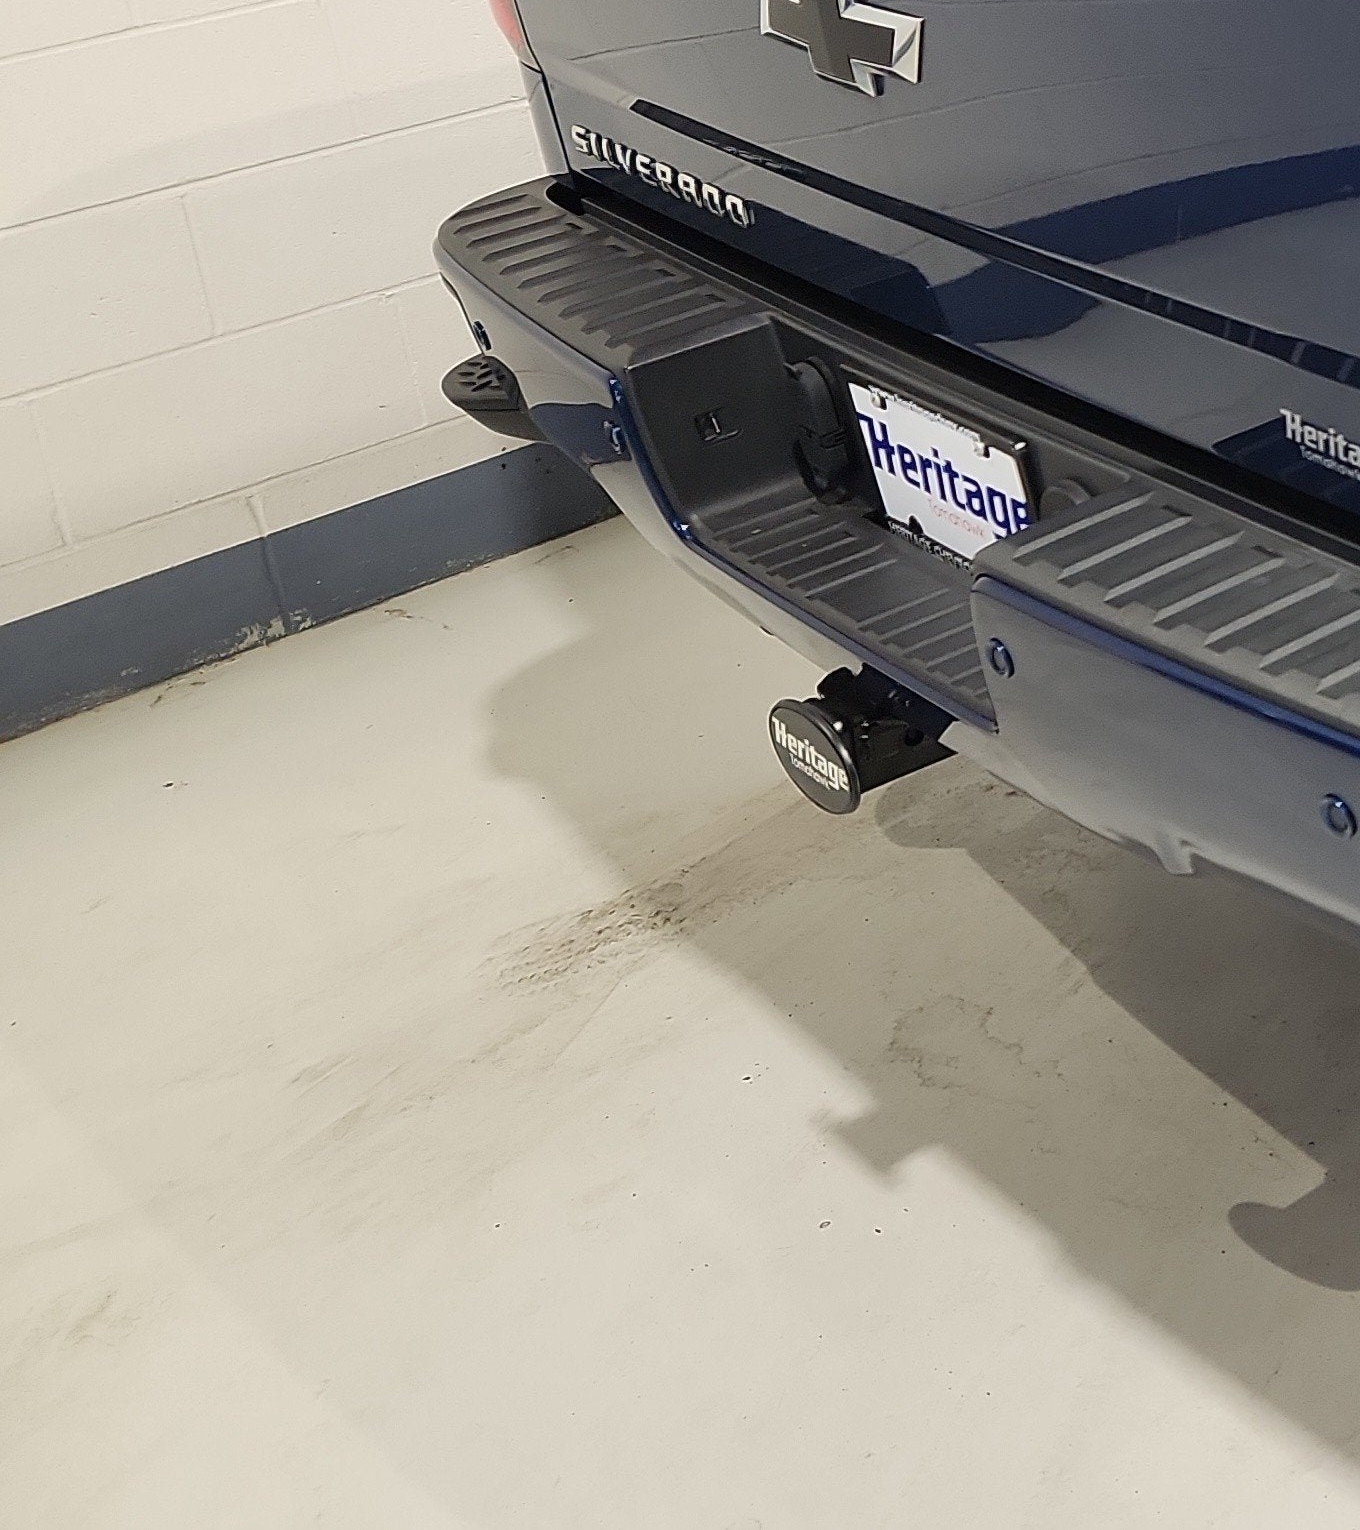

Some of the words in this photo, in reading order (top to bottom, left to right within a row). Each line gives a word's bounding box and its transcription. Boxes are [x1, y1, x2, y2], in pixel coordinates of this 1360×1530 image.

[571, 124, 749, 228] SILVERADO
[856, 410, 1031, 539] Heritage
[772, 716, 849, 792] Heritage
